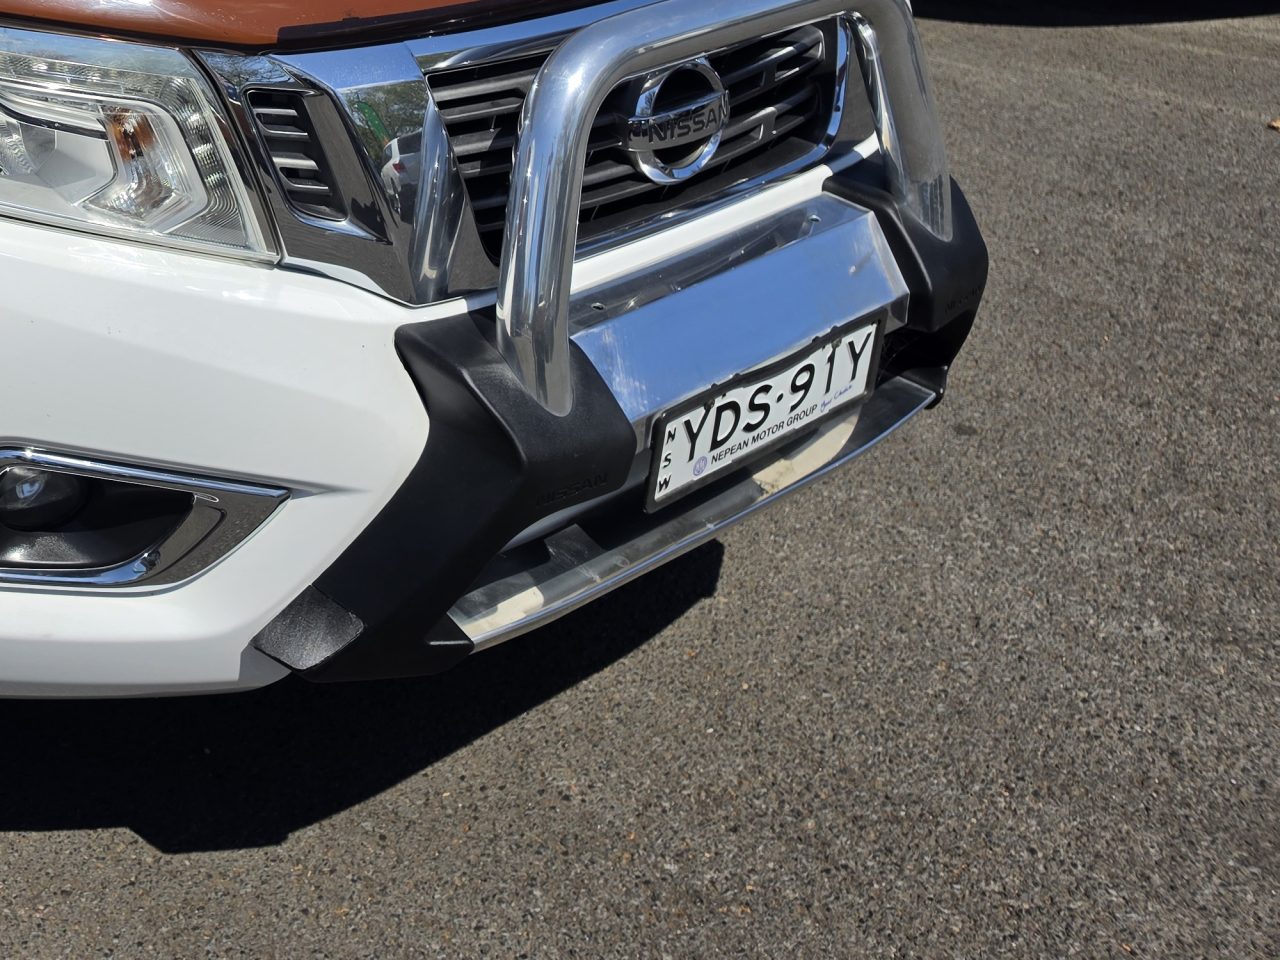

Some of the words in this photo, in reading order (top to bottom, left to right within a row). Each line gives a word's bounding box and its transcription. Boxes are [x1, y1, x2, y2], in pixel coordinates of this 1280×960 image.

[648, 93, 730, 143] NISSAN
[711, 441, 750, 464] NEPEAN
[751, 421, 785, 445] MOTOR
[786, 404, 818, 427] GROUP
